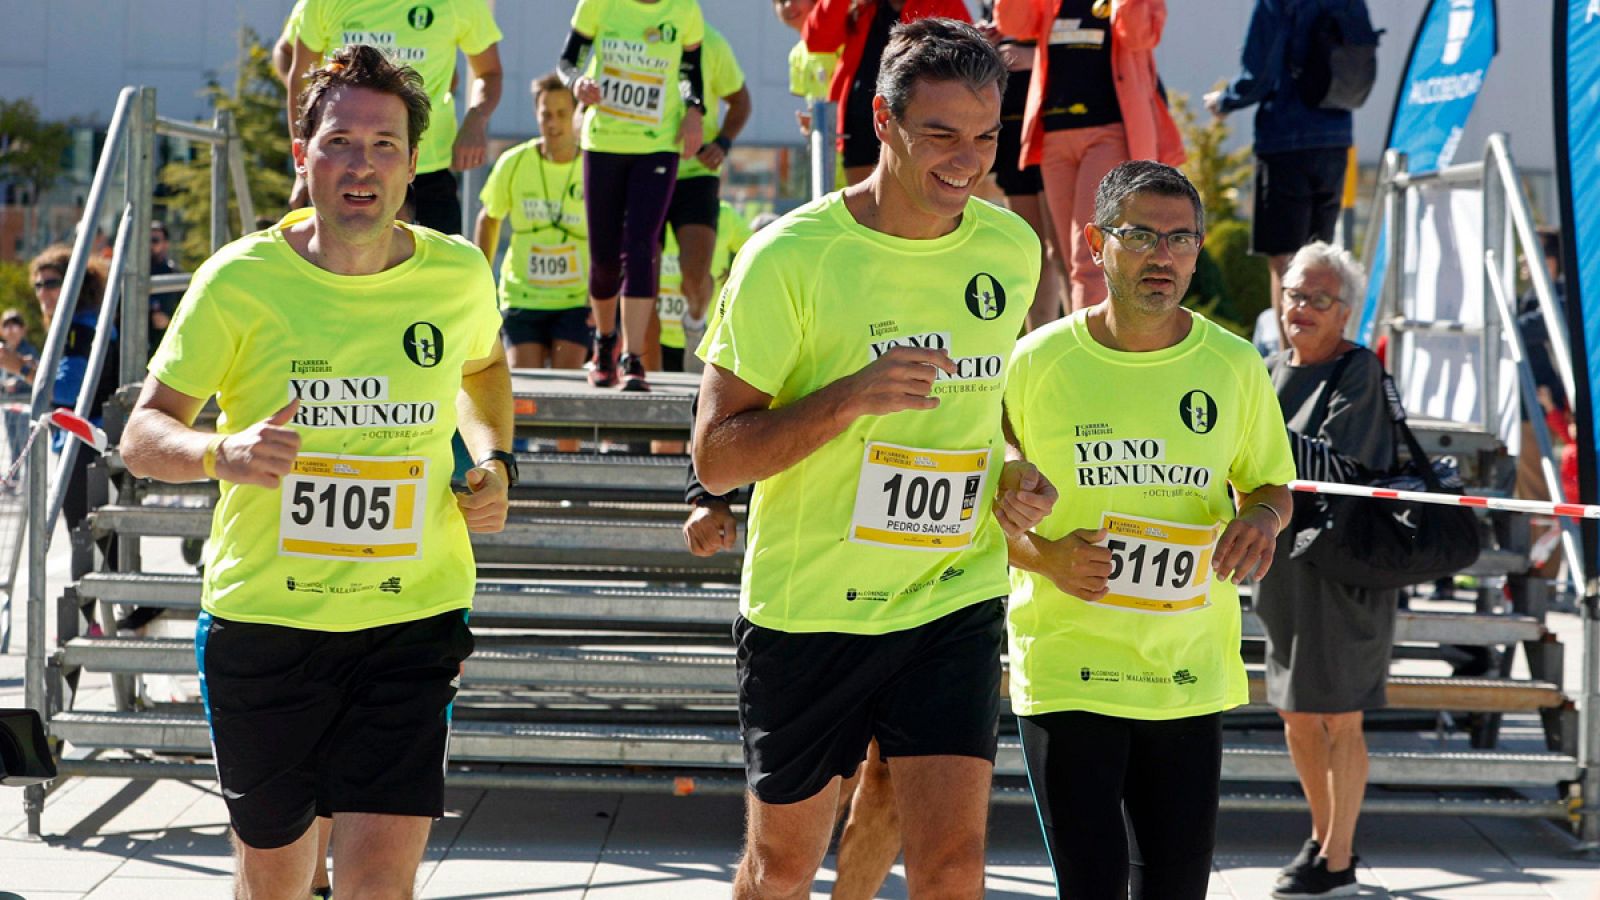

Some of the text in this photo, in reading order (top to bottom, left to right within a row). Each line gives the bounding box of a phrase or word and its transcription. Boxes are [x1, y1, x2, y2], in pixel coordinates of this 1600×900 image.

[602, 78, 645, 107] 1100
[530, 256, 567, 275] 5109
[290, 377, 381, 400] YO NO
[934, 383, 977, 395] OCTUBRE
[292, 402, 435, 427] RENUNCIO
[1075, 439, 1159, 463] YO NO
[1077, 464, 1209, 488] RENUNCIO
[291, 480, 391, 531] 5105
[883, 473, 951, 521] 100
[887, 520, 961, 534] PEDRO SÁNCHEZ
[1108, 540, 1194, 588] 5119
